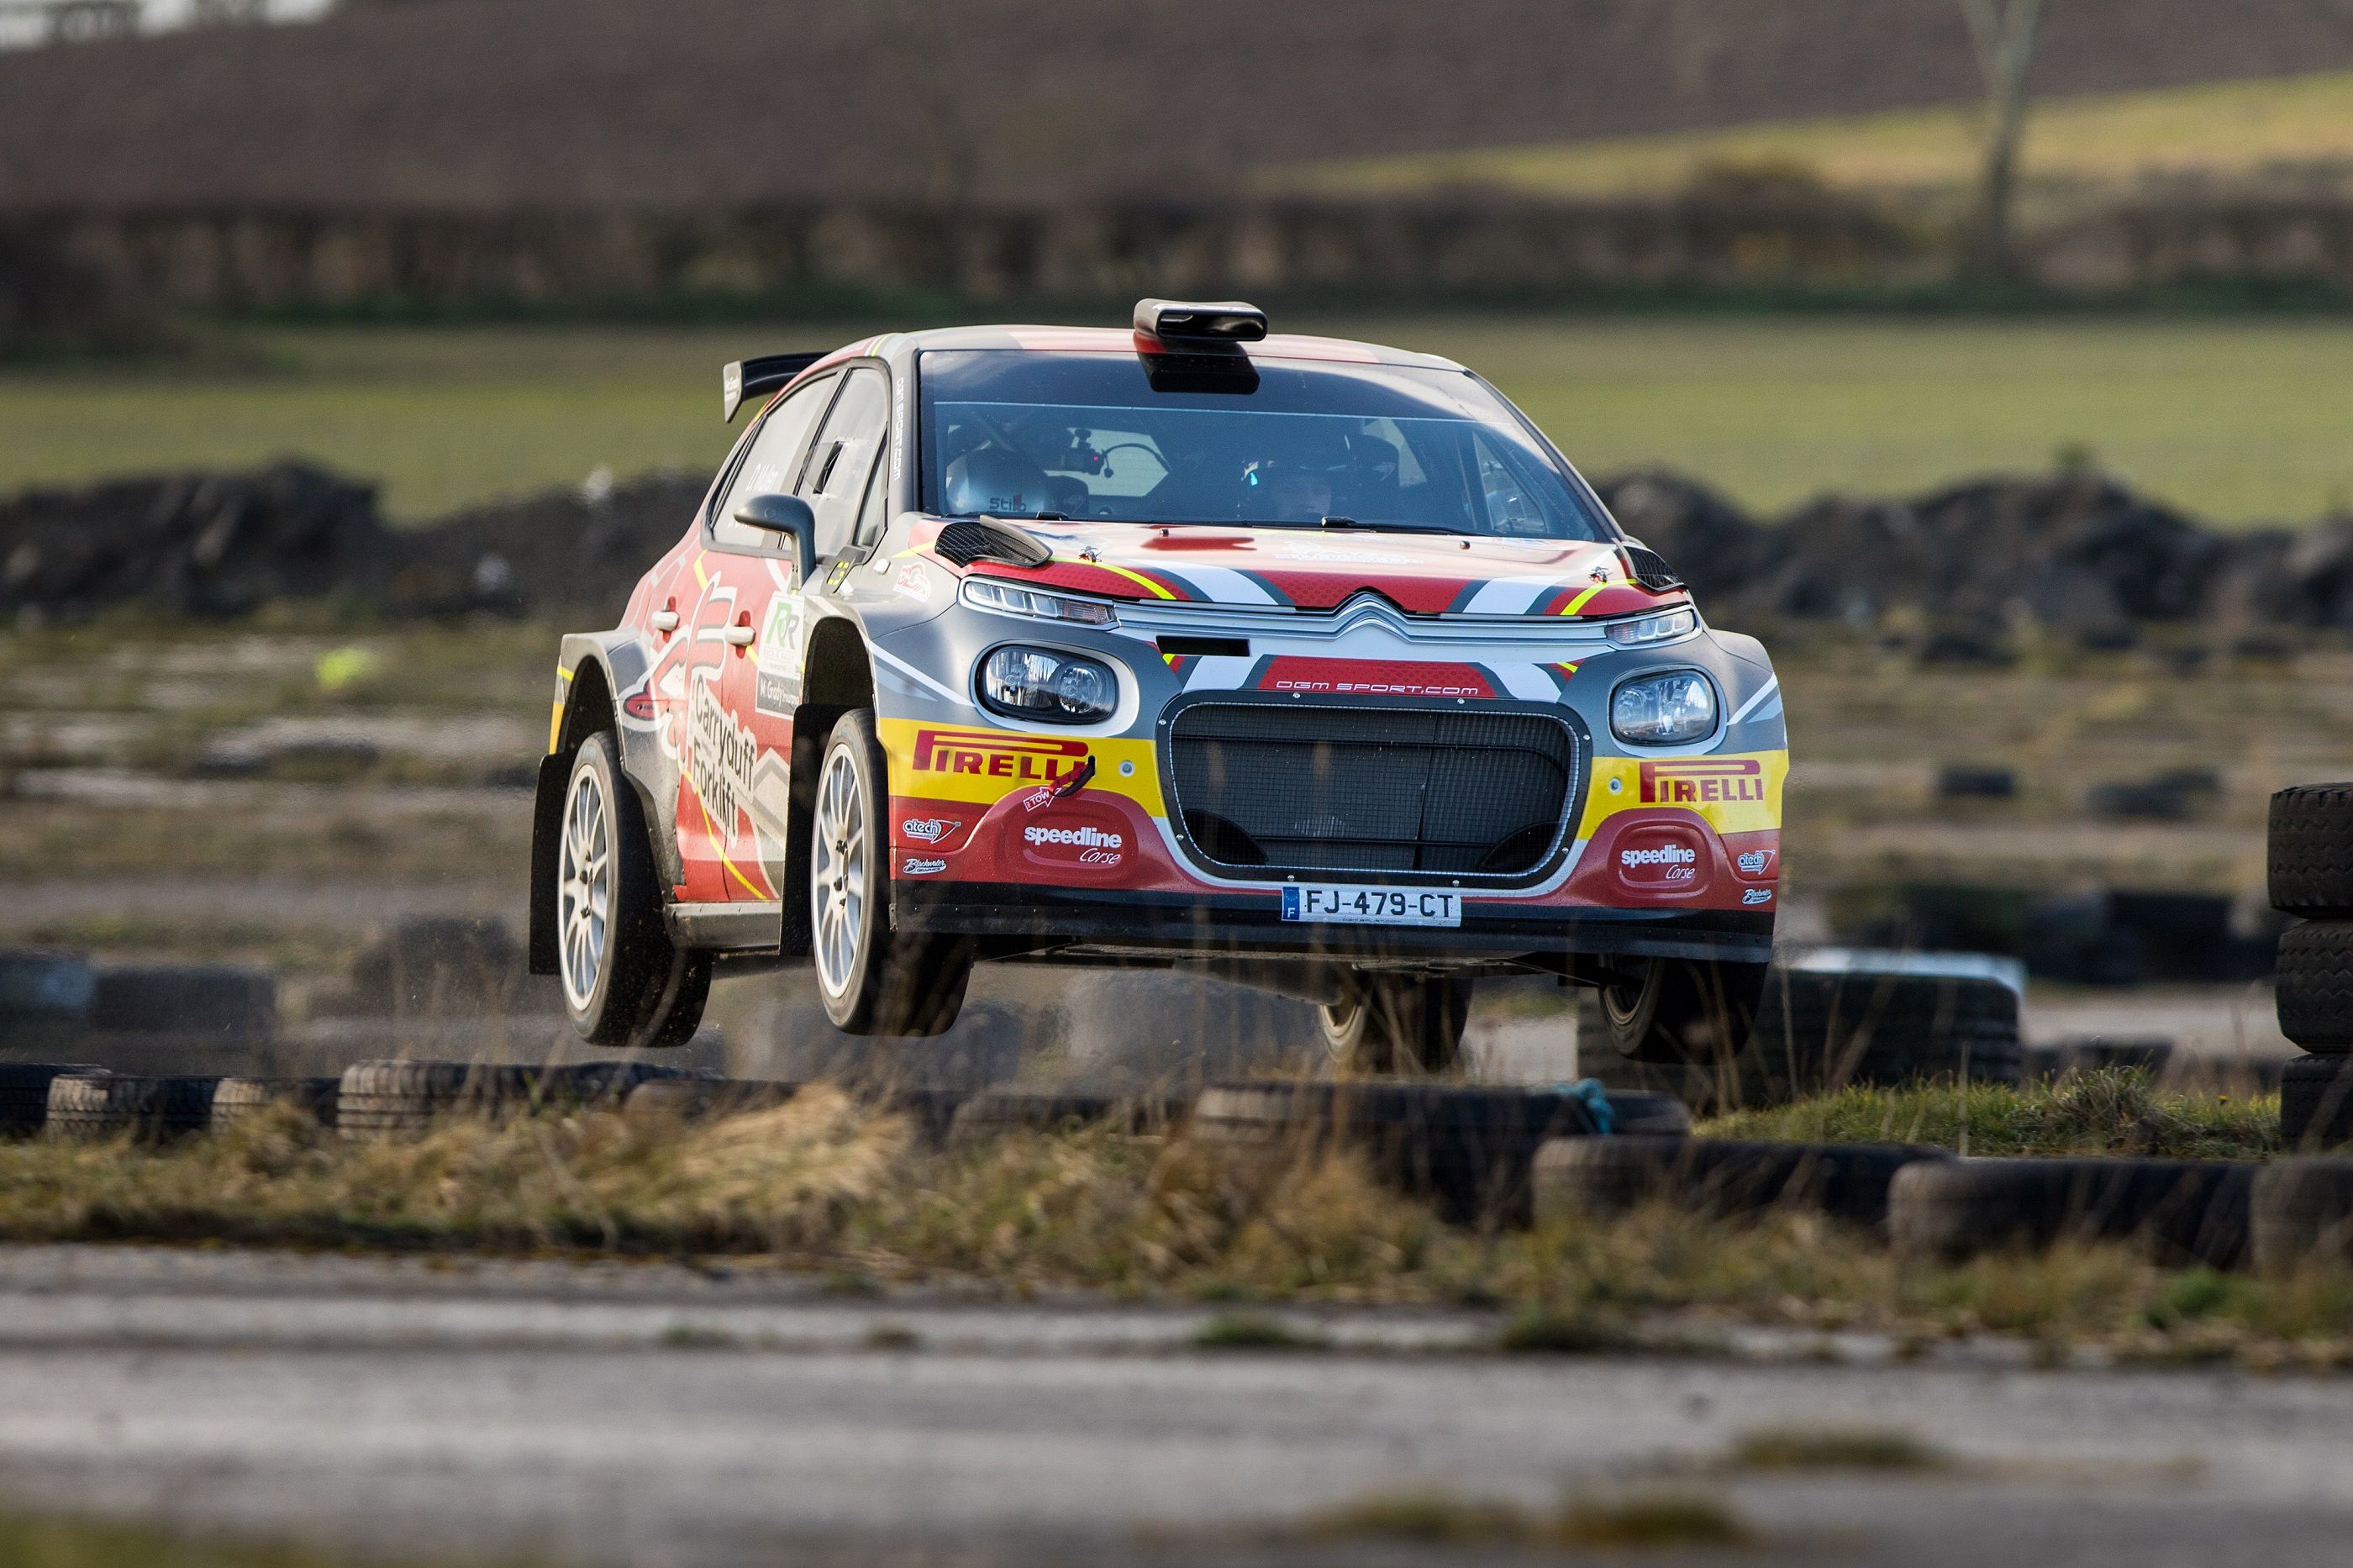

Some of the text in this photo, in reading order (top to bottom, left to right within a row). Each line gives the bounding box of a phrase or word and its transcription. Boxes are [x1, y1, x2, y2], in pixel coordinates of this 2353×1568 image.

[1276, 681, 1479, 695] DGM SPORT.COM
[696, 674, 755, 792] Carryduff
[693, 734, 737, 837] Forklift
[1639, 759, 1764, 803] PIRELLI
[1029, 790, 1050, 805] TOW
[904, 819, 940, 834] atech
[1024, 826, 1123, 849] speedline
[1079, 847, 1121, 865] Corse
[1621, 844, 1696, 869] speedline
[1739, 851, 1763, 866] atech
[1666, 864, 1696, 879] Corse
[1287, 889, 1454, 918] F FJ-479-CT
